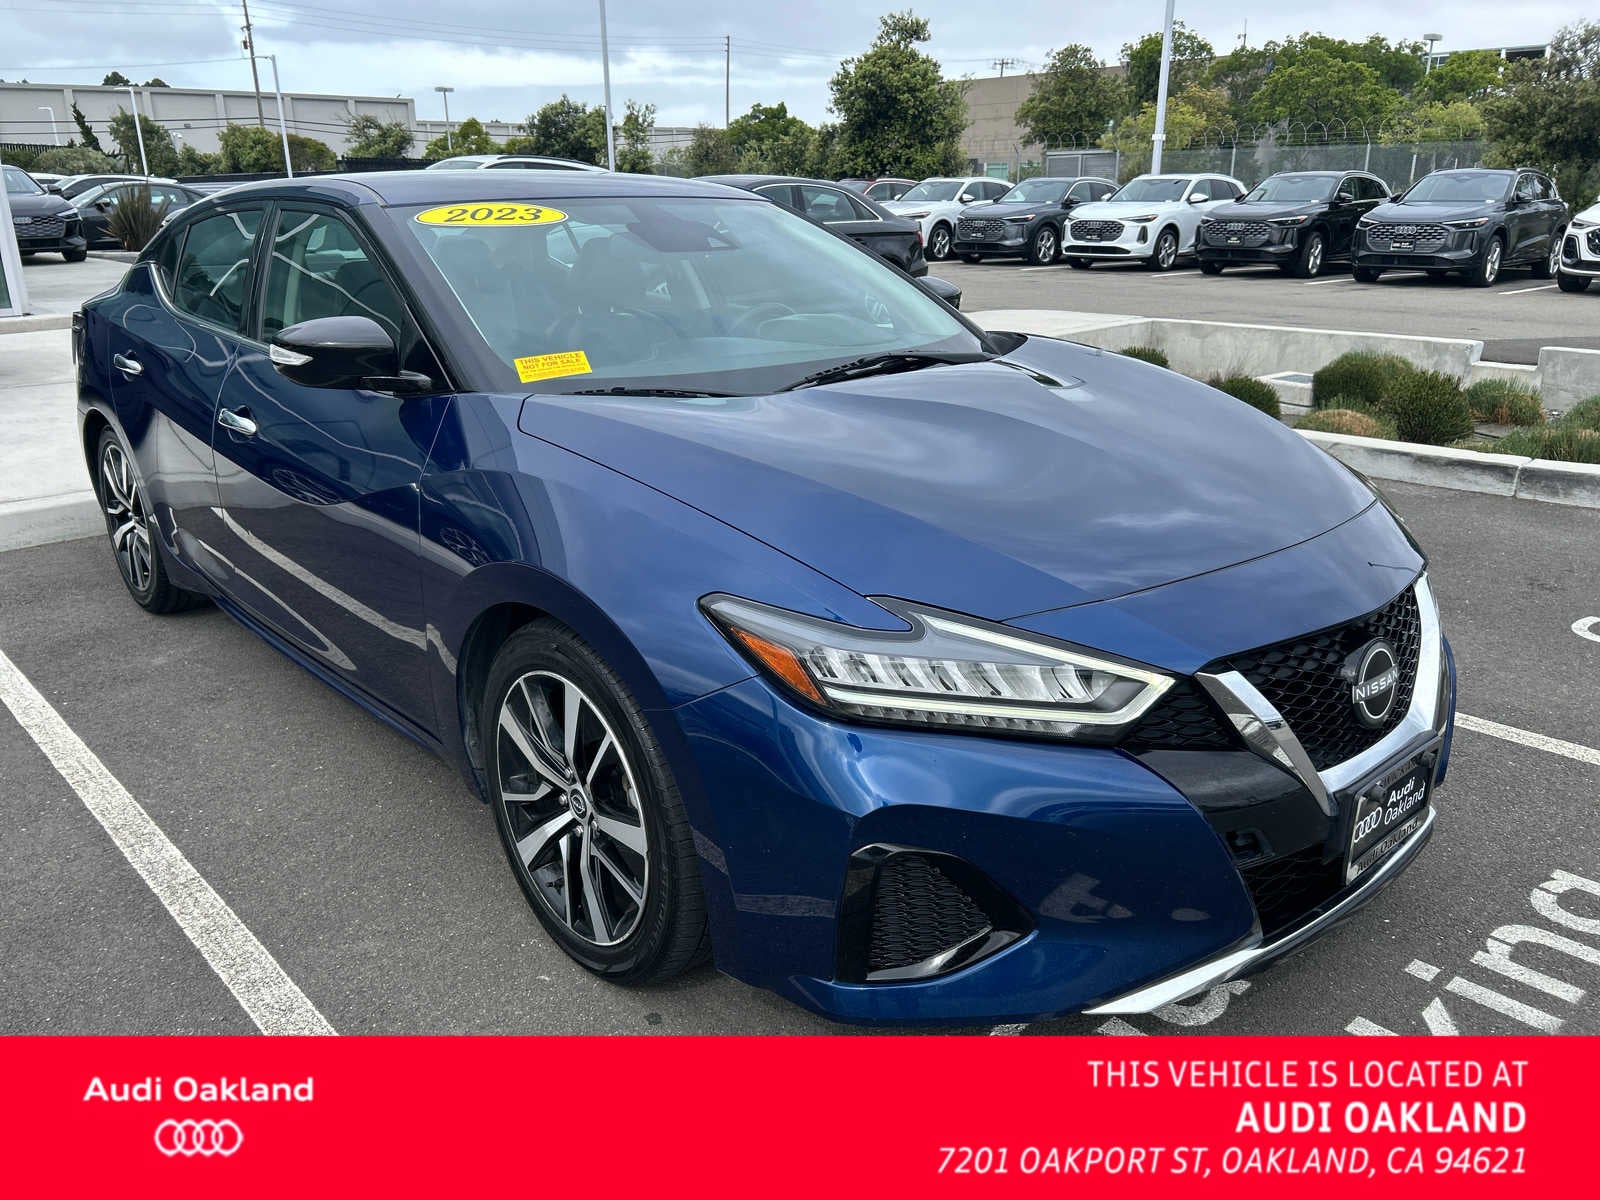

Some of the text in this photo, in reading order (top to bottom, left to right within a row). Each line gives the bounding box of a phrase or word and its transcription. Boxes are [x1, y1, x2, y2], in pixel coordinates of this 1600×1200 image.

[443, 207, 543, 222] 2023
[520, 353, 581, 365] THIS VEHICLE
[1355, 667, 1398, 700] NISSAN
[1384, 779, 1426, 825] Oakland
[1386, 776, 1416, 807] Audi
